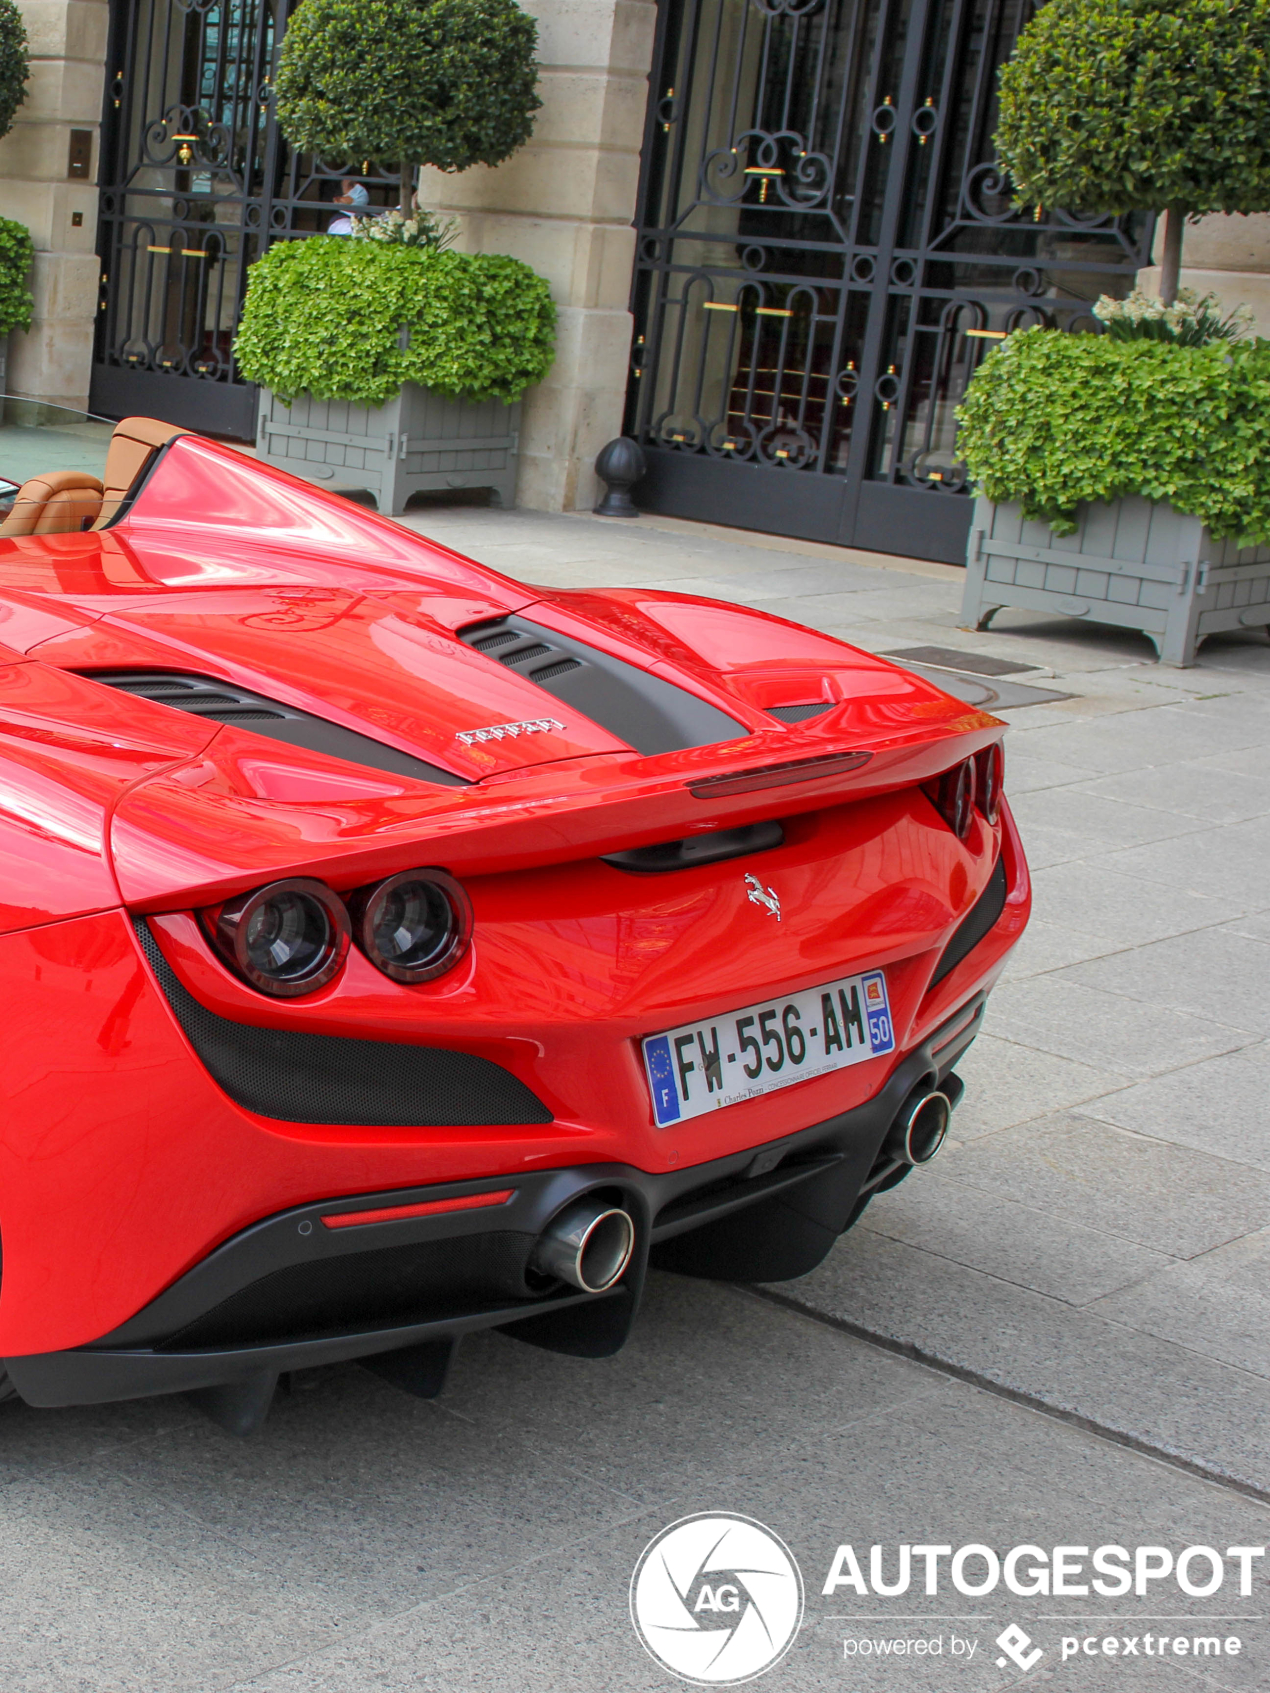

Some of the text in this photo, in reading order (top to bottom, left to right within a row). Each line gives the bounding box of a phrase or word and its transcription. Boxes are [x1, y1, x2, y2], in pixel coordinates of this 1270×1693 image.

[455, 718, 567, 747] Ferrari
[674, 985, 865, 1101] FW-556-AM
[870, 1016, 889, 1045] 50
[662, 1089, 668, 1107] F
